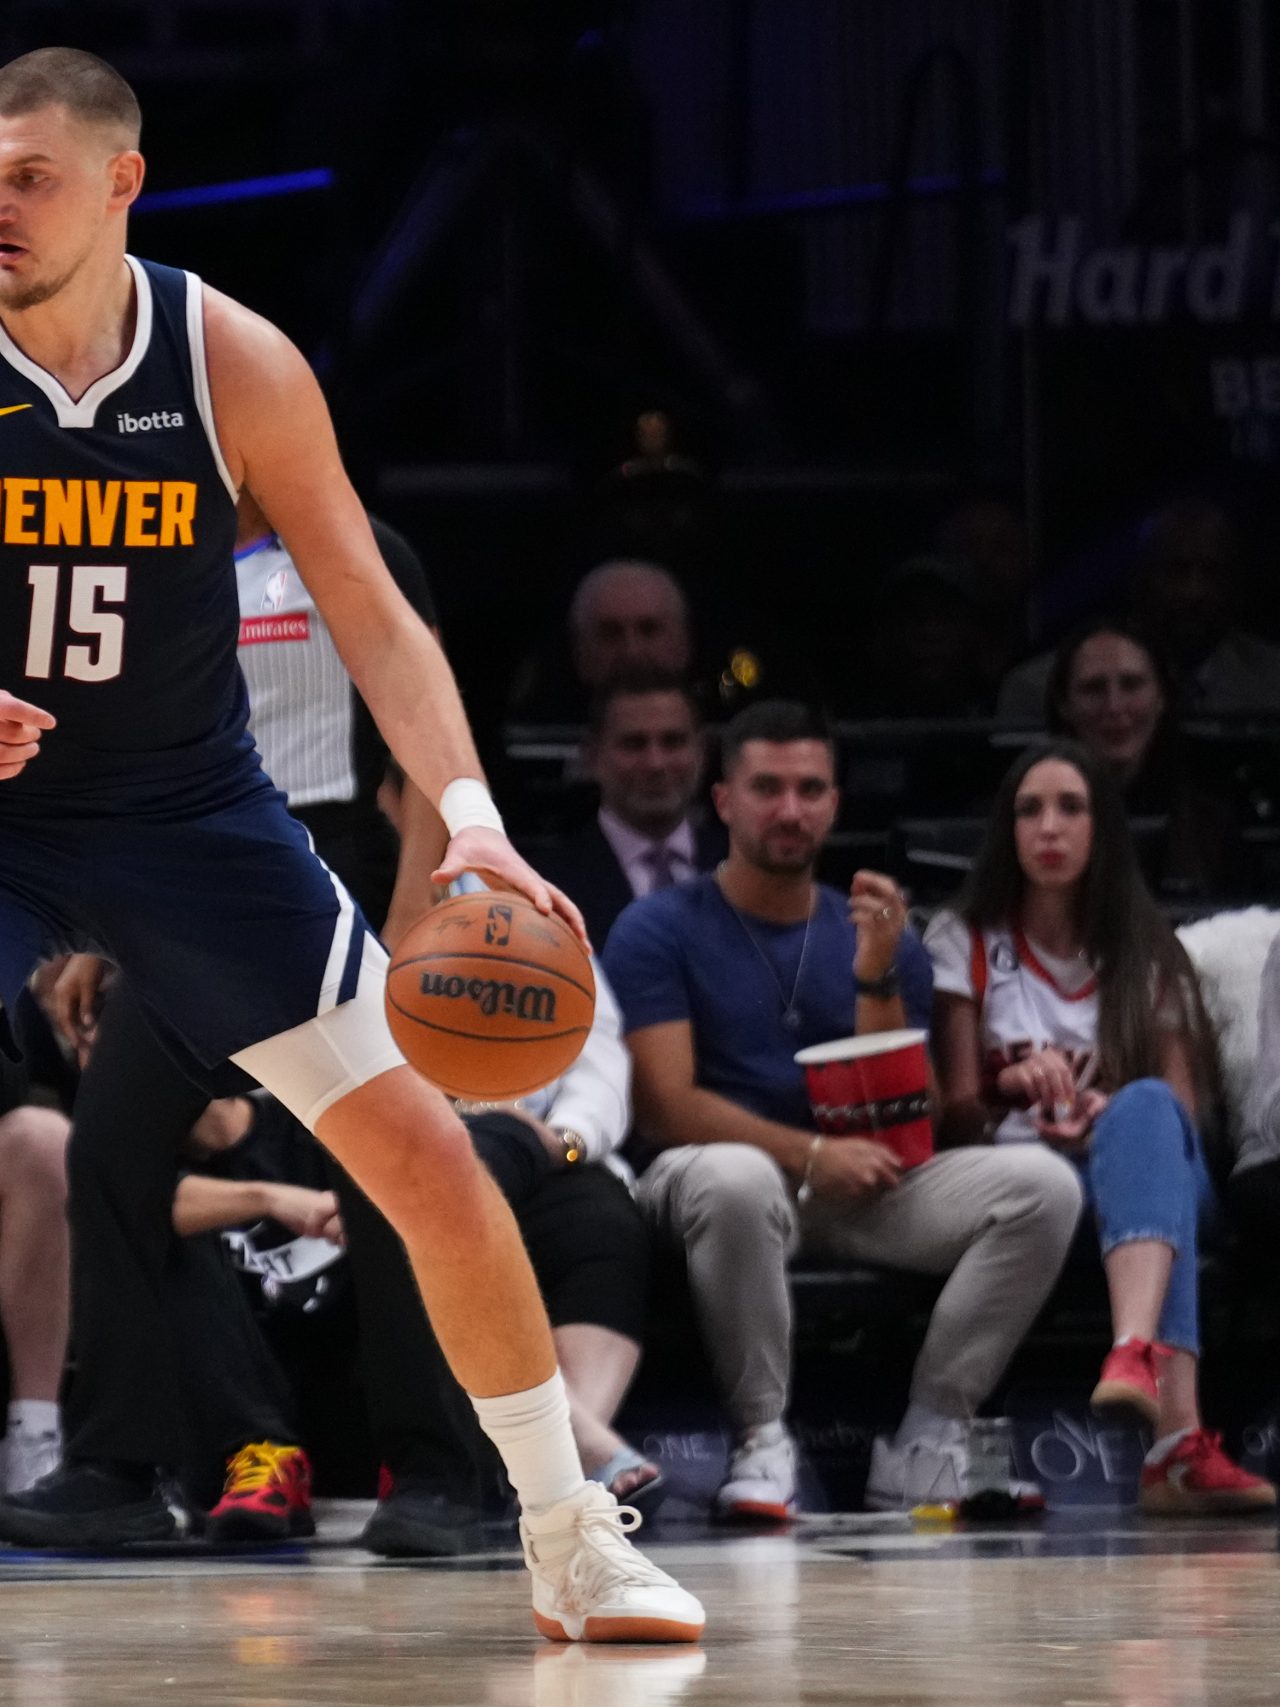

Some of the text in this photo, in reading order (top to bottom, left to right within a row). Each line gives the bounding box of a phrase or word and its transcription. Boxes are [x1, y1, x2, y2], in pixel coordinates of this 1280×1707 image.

[1006, 213, 1252, 327] Hard
[117, 411, 185, 434] ibotta
[24, 565, 128, 682] 15
[420, 970, 568, 1023] Wilson
[643, 1430, 712, 1462] ONE
[1030, 1409, 1138, 1483] ONE
